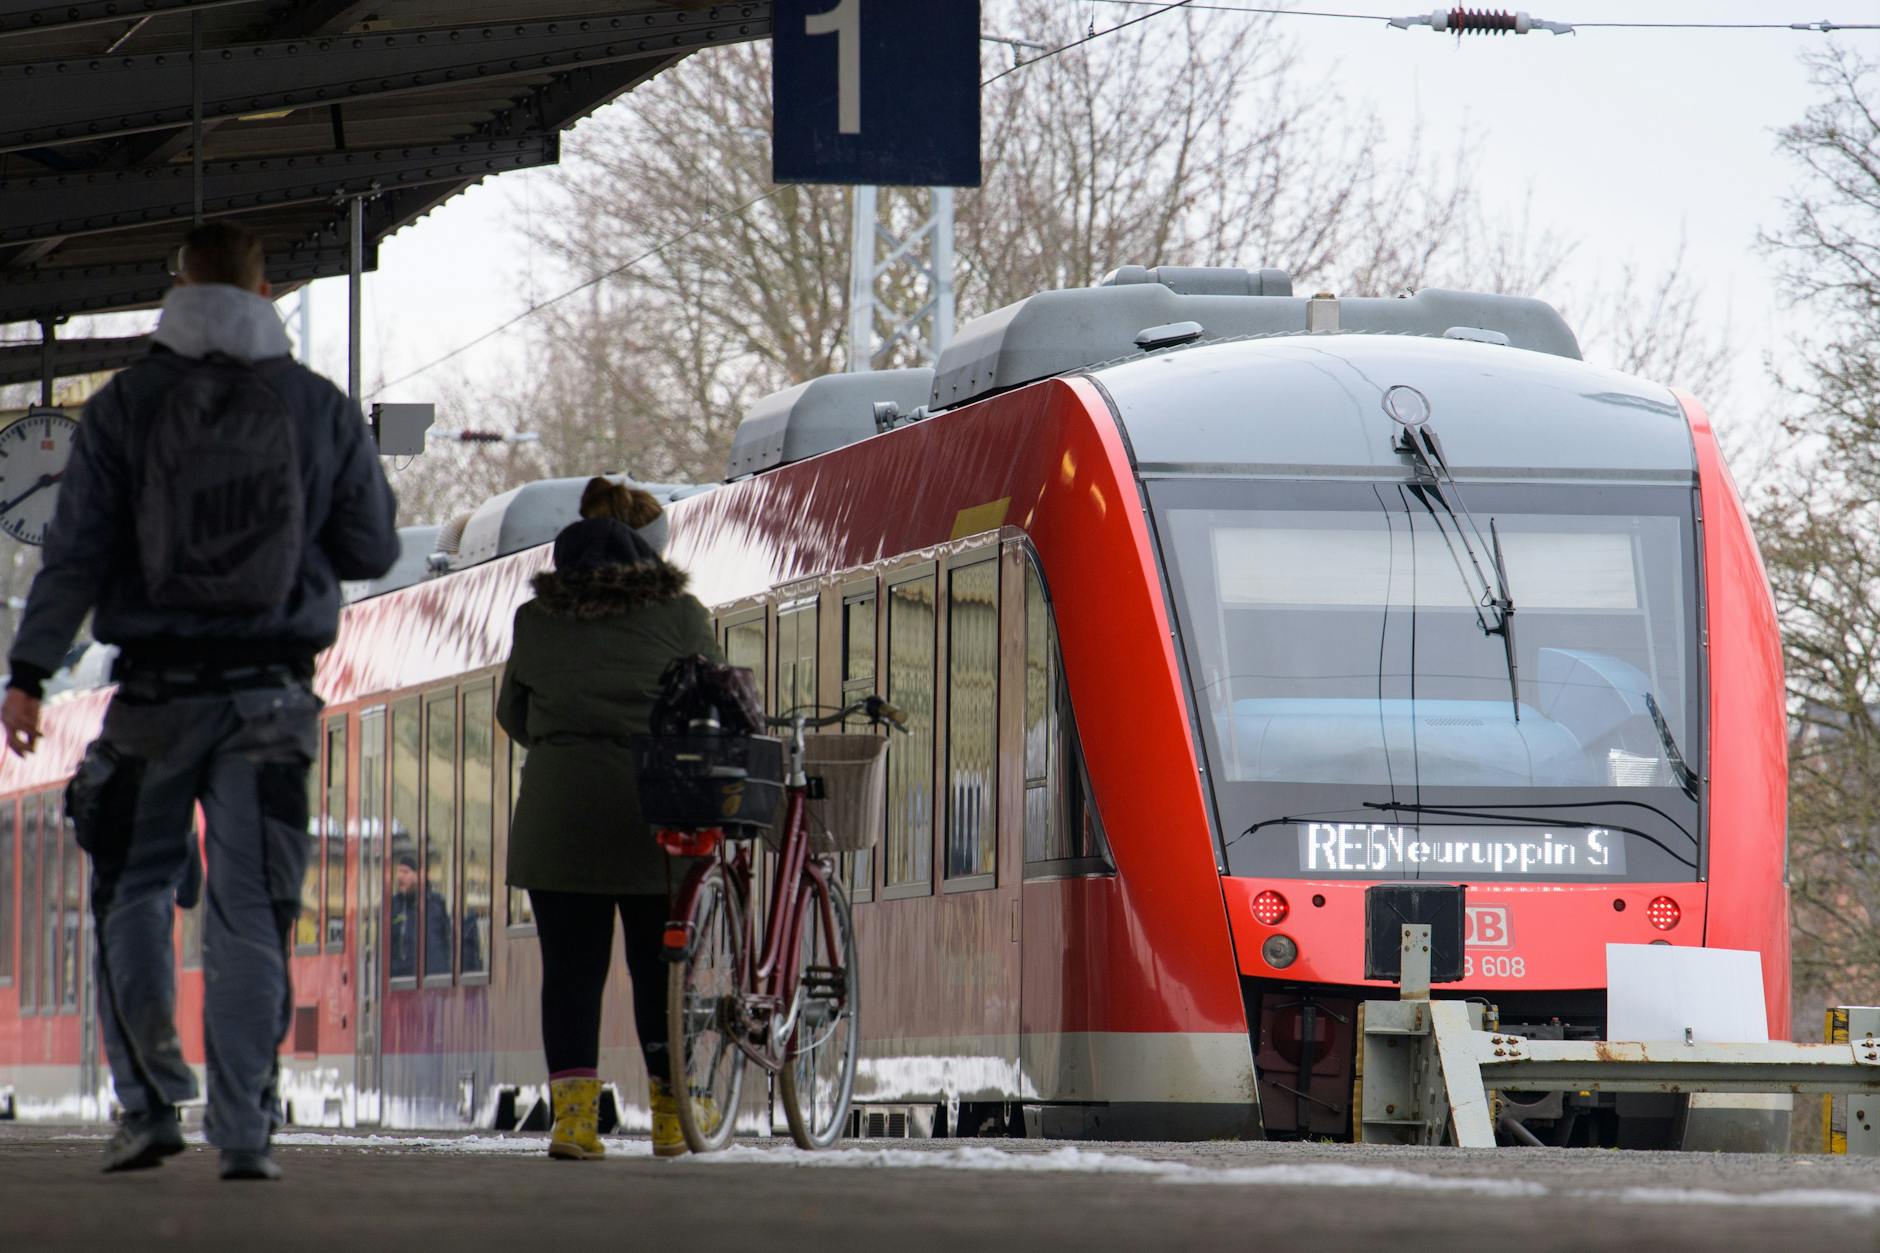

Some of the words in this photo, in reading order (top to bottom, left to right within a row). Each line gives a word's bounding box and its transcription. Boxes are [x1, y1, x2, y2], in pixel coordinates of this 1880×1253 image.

[805, 0, 860, 134] 1
[1387, 827, 1575, 872] Neuruppin
[1587, 829, 1609, 865] S
[1481, 956, 1526, 978] 608
